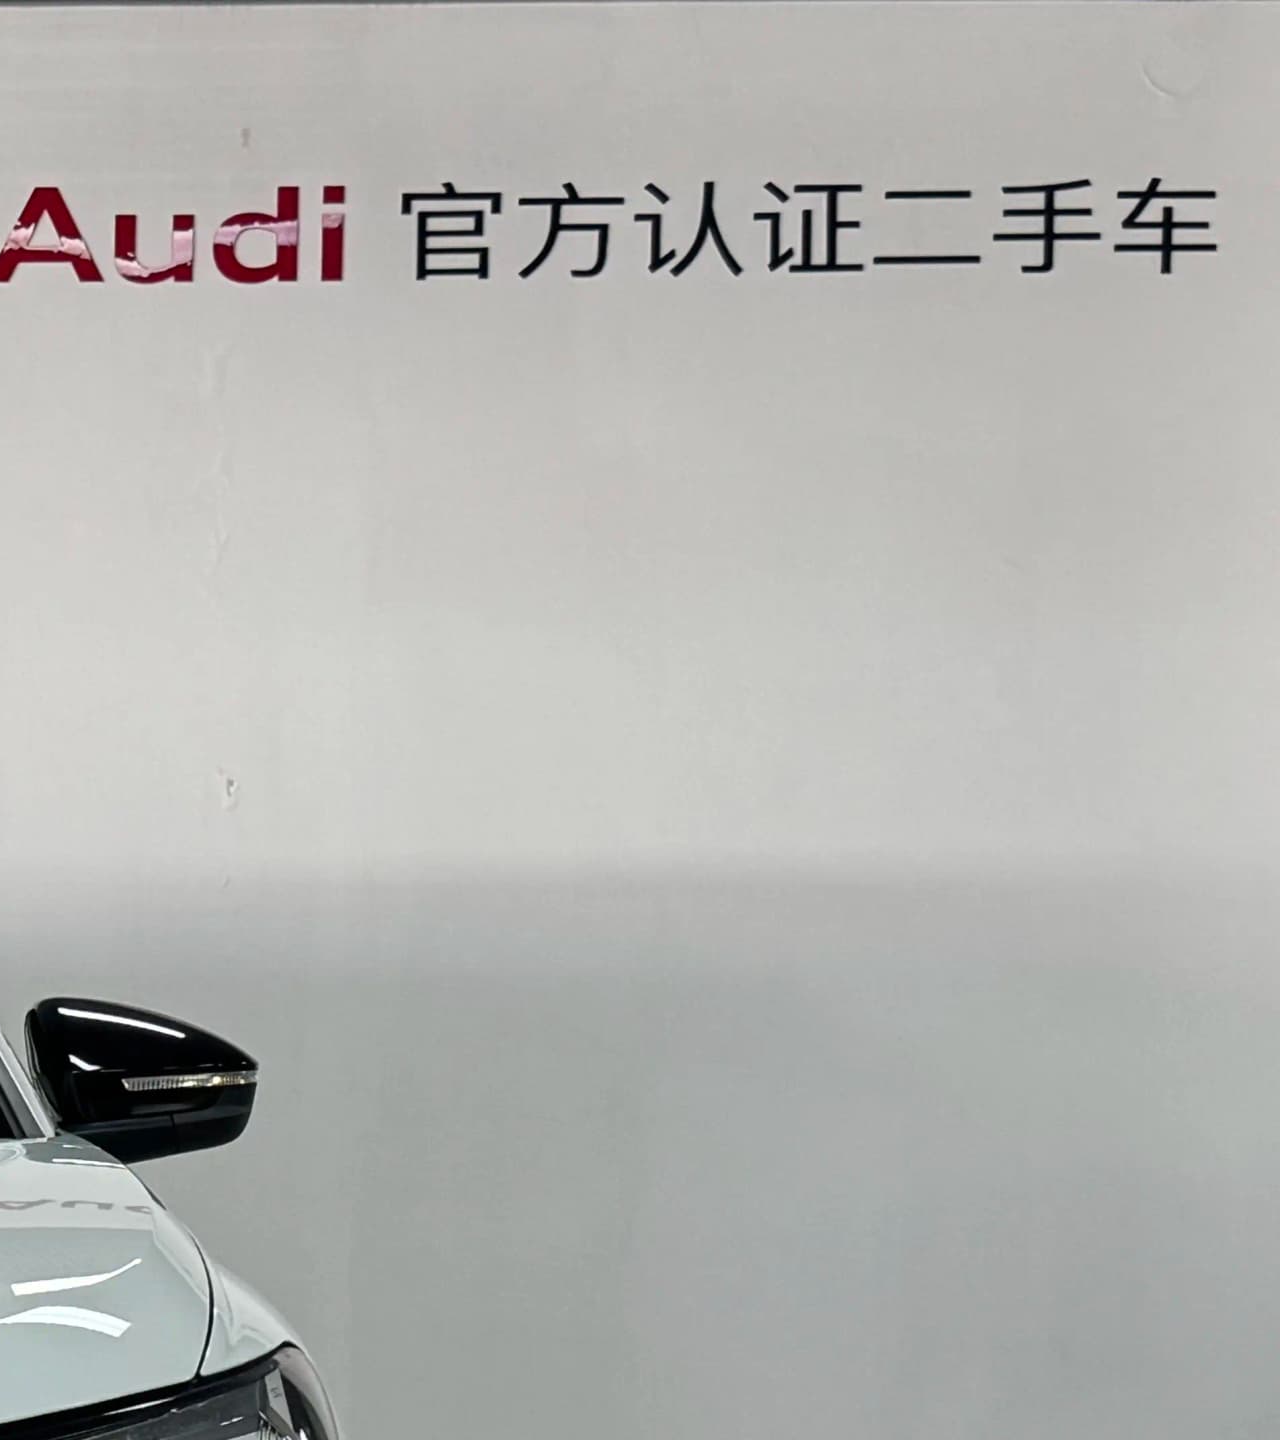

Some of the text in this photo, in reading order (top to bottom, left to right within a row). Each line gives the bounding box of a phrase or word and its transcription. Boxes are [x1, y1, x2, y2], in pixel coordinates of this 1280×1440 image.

[400, 178, 1219, 281] 官方认证二手车
